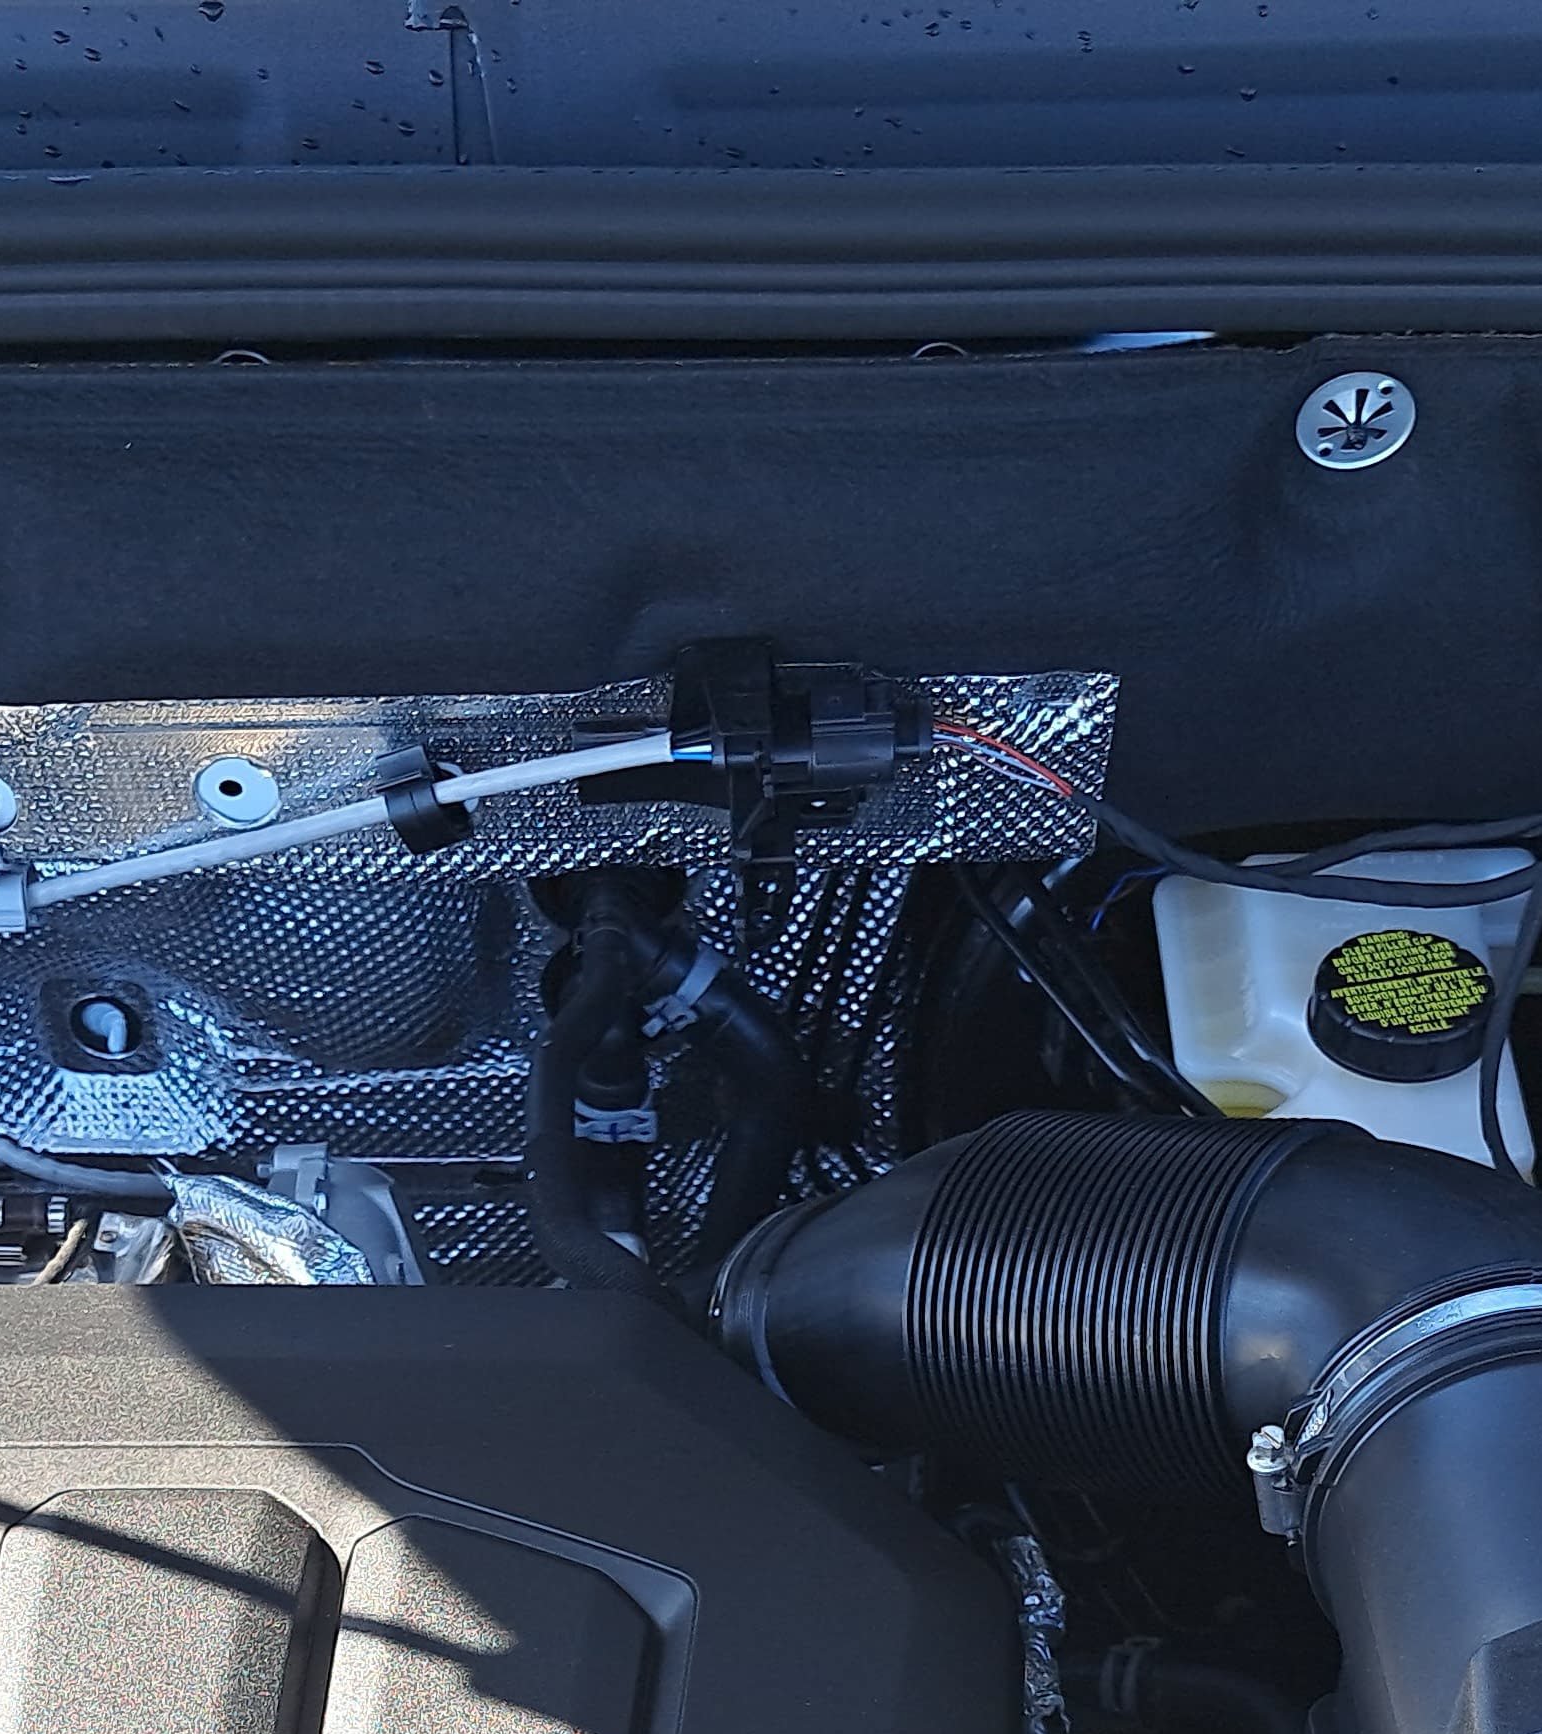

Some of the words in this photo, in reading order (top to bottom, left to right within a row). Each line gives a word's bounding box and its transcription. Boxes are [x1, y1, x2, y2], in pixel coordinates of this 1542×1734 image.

[1332, 955, 1371, 967] BEFORE
[1431, 942, 1452, 952] USE
[1342, 945, 1377, 958] CLEAN
[1378, 939, 1411, 951] FILLER
[1413, 936, 1433, 945] CAP
[1338, 965, 1365, 975] ONLY
[1367, 962, 1386, 970] DOT
[1388, 960, 1395, 968] 4
[1397, 956, 1426, 966] FLUID
[1428, 950, 1456, 961] FROM
[1471, 967, 1484, 976] LE
[1356, 970, 1393, 982] SEALED
[1347, 991, 1397, 1005] BOUCHON
[1435, 982, 1446, 990] DE
[1450, 988, 1470, 998] QUE
[1472, 985, 1486, 994] DU
[1357, 1008, 1397, 1022] LIQUIDE
[1426, 995, 1482, 1011] PROVENANT
[1407, 1007, 1470, 1023] CONTENANT
